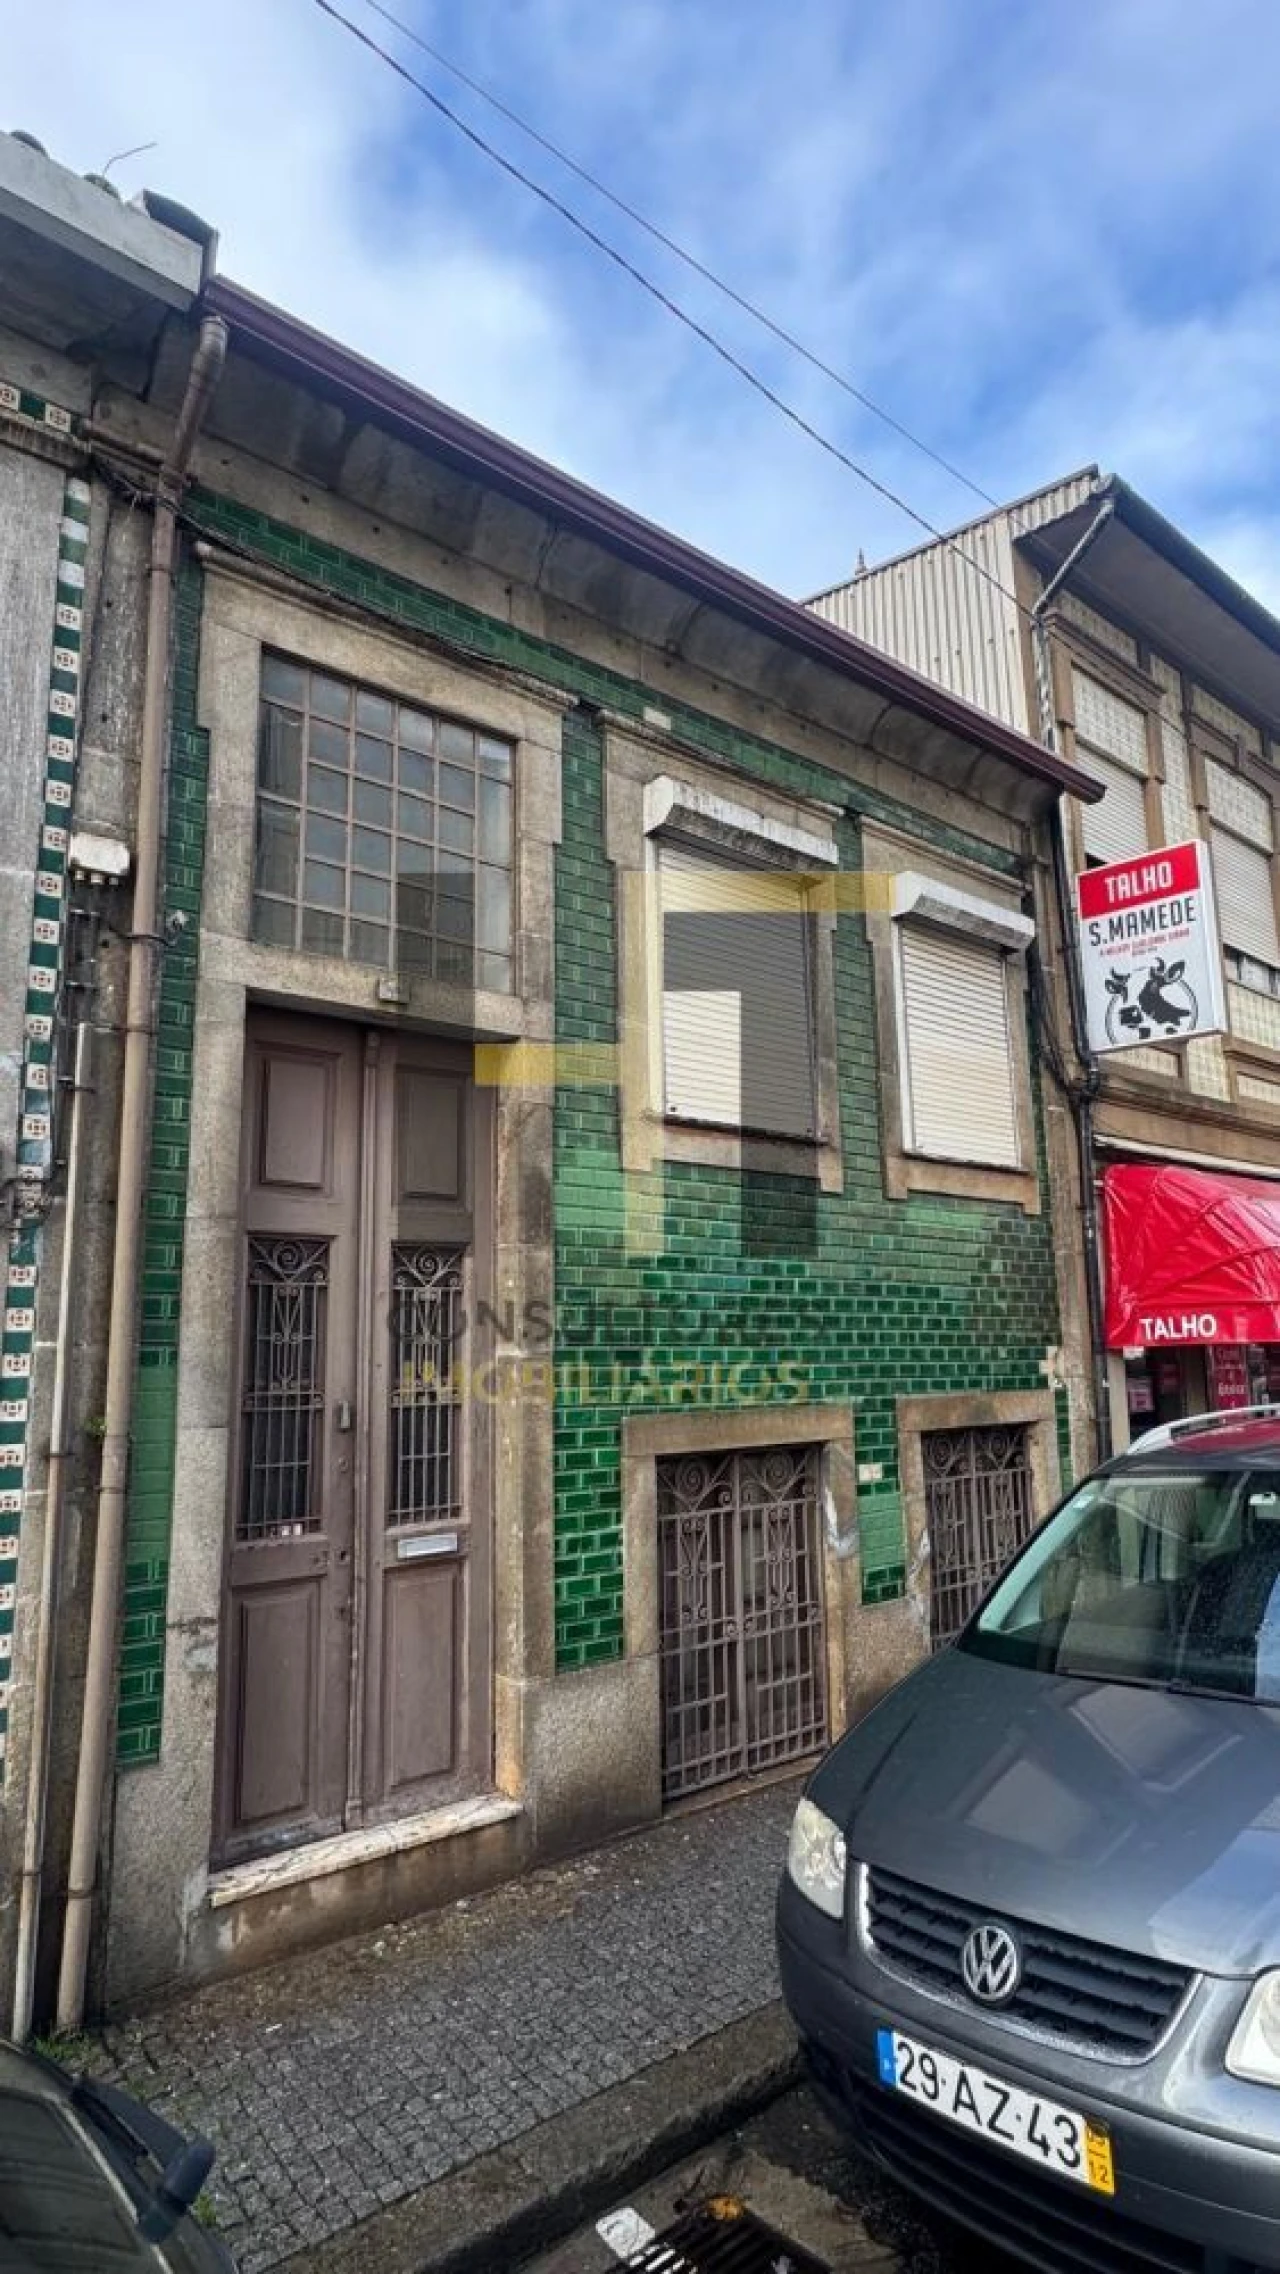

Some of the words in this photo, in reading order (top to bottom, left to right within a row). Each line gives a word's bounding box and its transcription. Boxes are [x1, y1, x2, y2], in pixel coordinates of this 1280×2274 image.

[1104, 862, 1173, 903] TALHO
[1089, 896, 1197, 946] S.MAMEDE
[1138, 1313, 1217, 1340] TALHO
